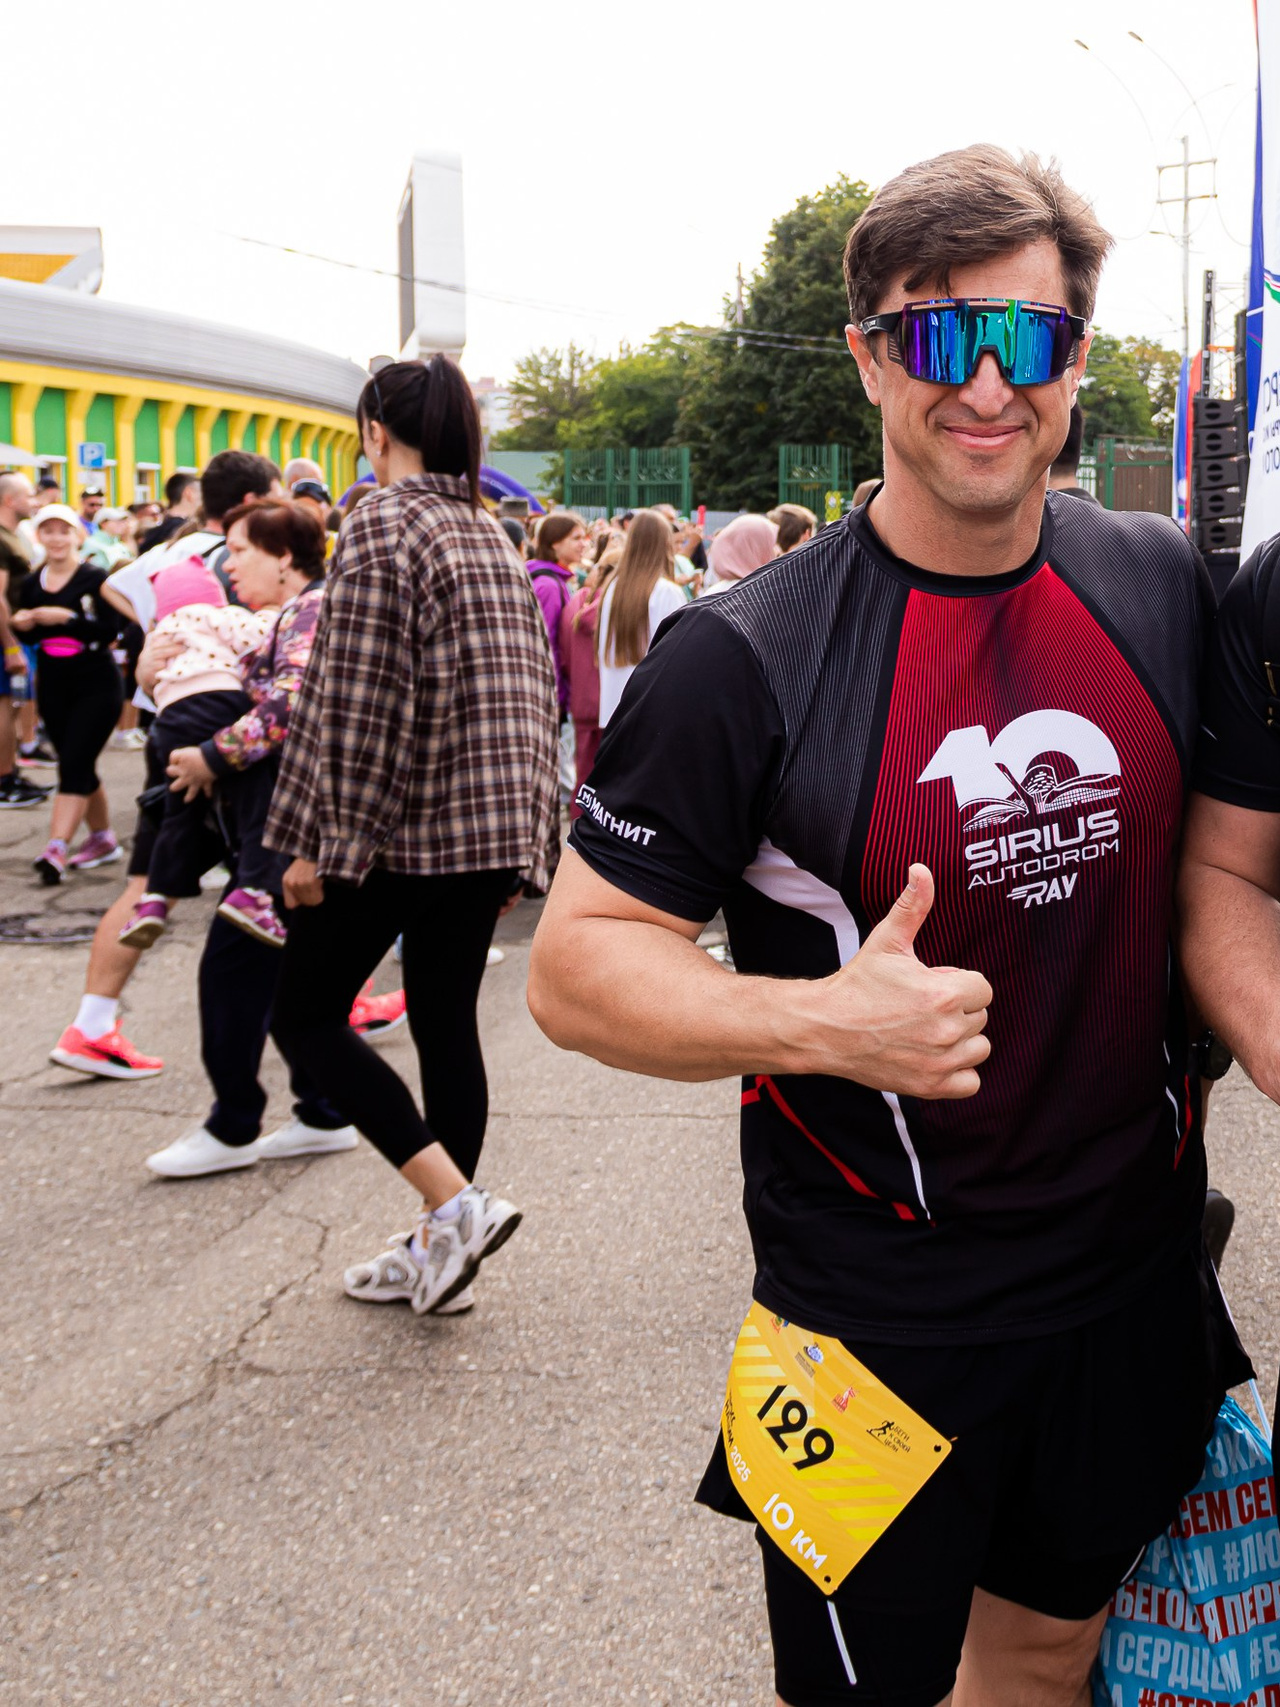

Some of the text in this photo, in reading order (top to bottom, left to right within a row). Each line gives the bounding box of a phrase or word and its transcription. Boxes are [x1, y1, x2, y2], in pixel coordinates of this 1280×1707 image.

[916, 709, 1122, 812] 10
[589, 797, 657, 846] МАГНИТ
[964, 808, 1120, 872] SIRIUS
[967, 838, 1119, 890] AUTODROM
[757, 1385, 834, 1470] 129
[730, 1446, 751, 1482] 2025
[763, 1493, 794, 1530] 10
